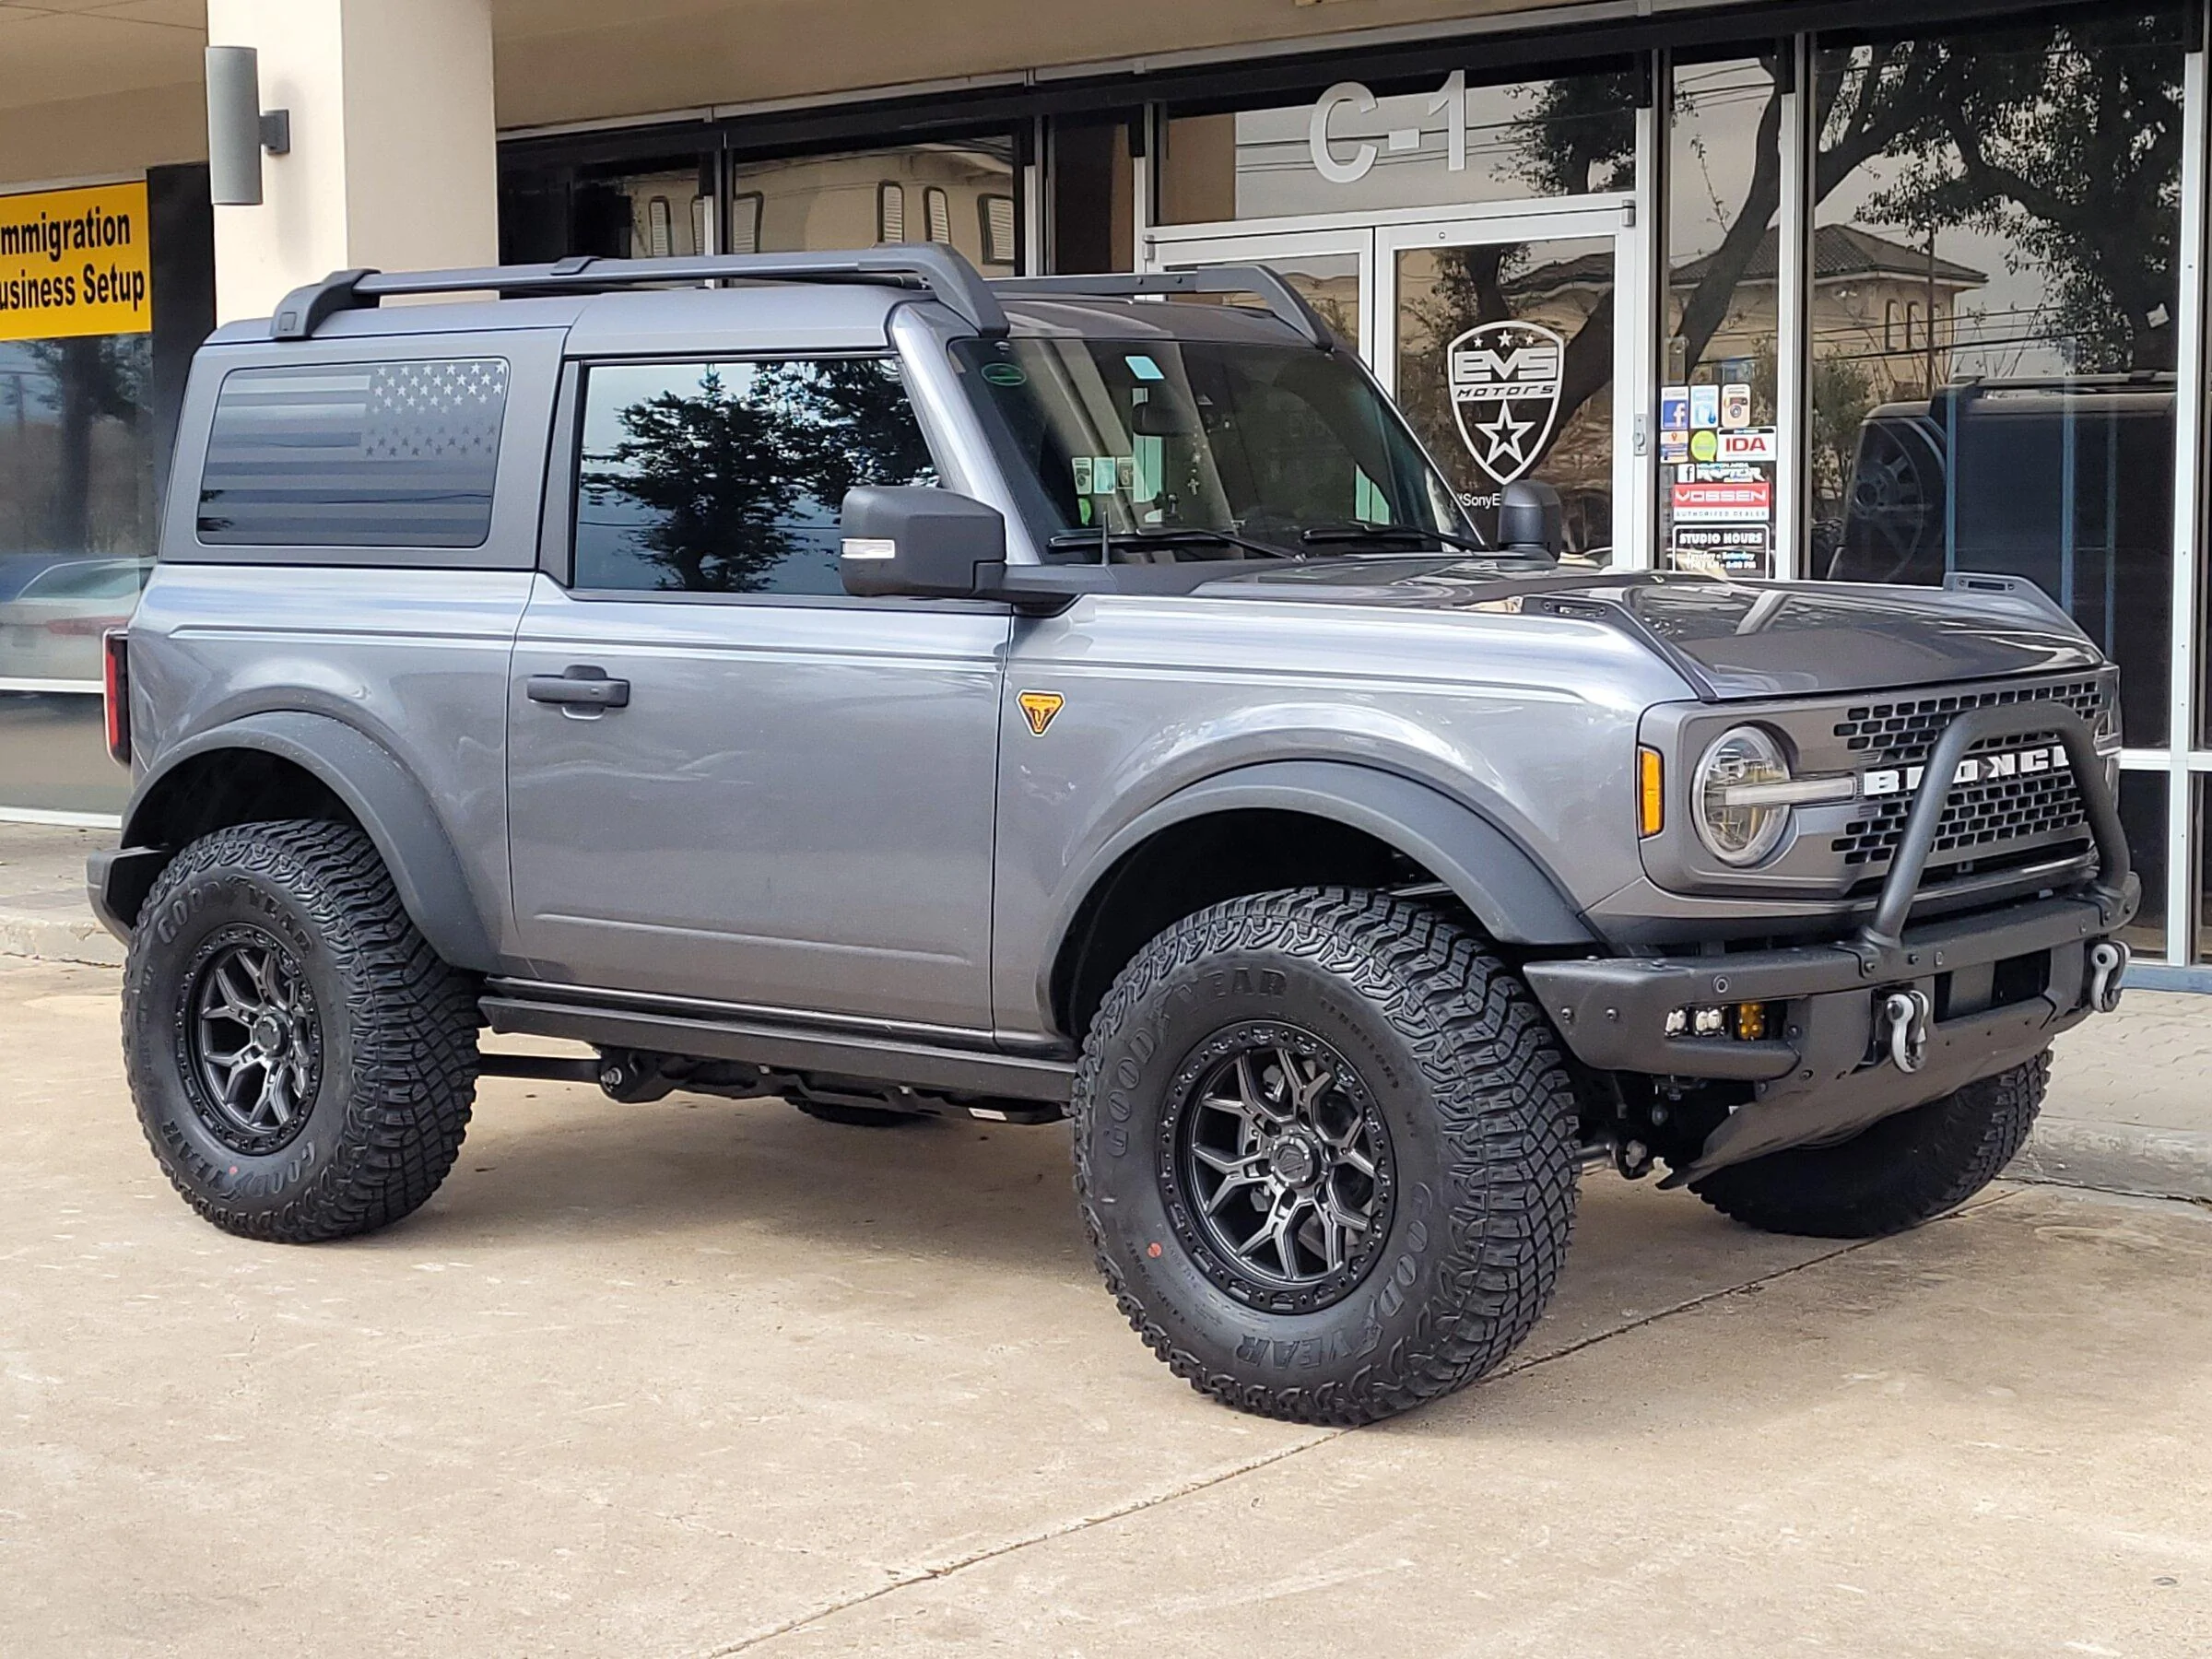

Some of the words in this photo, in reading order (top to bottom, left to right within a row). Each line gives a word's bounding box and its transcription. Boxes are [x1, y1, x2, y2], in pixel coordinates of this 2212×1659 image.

[1310, 70, 1465, 182] C-1
[0, 206, 130, 262] mmigration
[0, 269, 76, 310] usiness
[83, 264, 144, 312] Setup
[1456, 385, 1556, 397] MOTORS
[1725, 438, 1766, 452] IDA
[1457, 492, 1501, 510] SonyE
[1676, 489, 1766, 502] VOSSEN
[1679, 533, 1721, 544] STUDIO
[1724, 532, 1762, 544] HOURS
